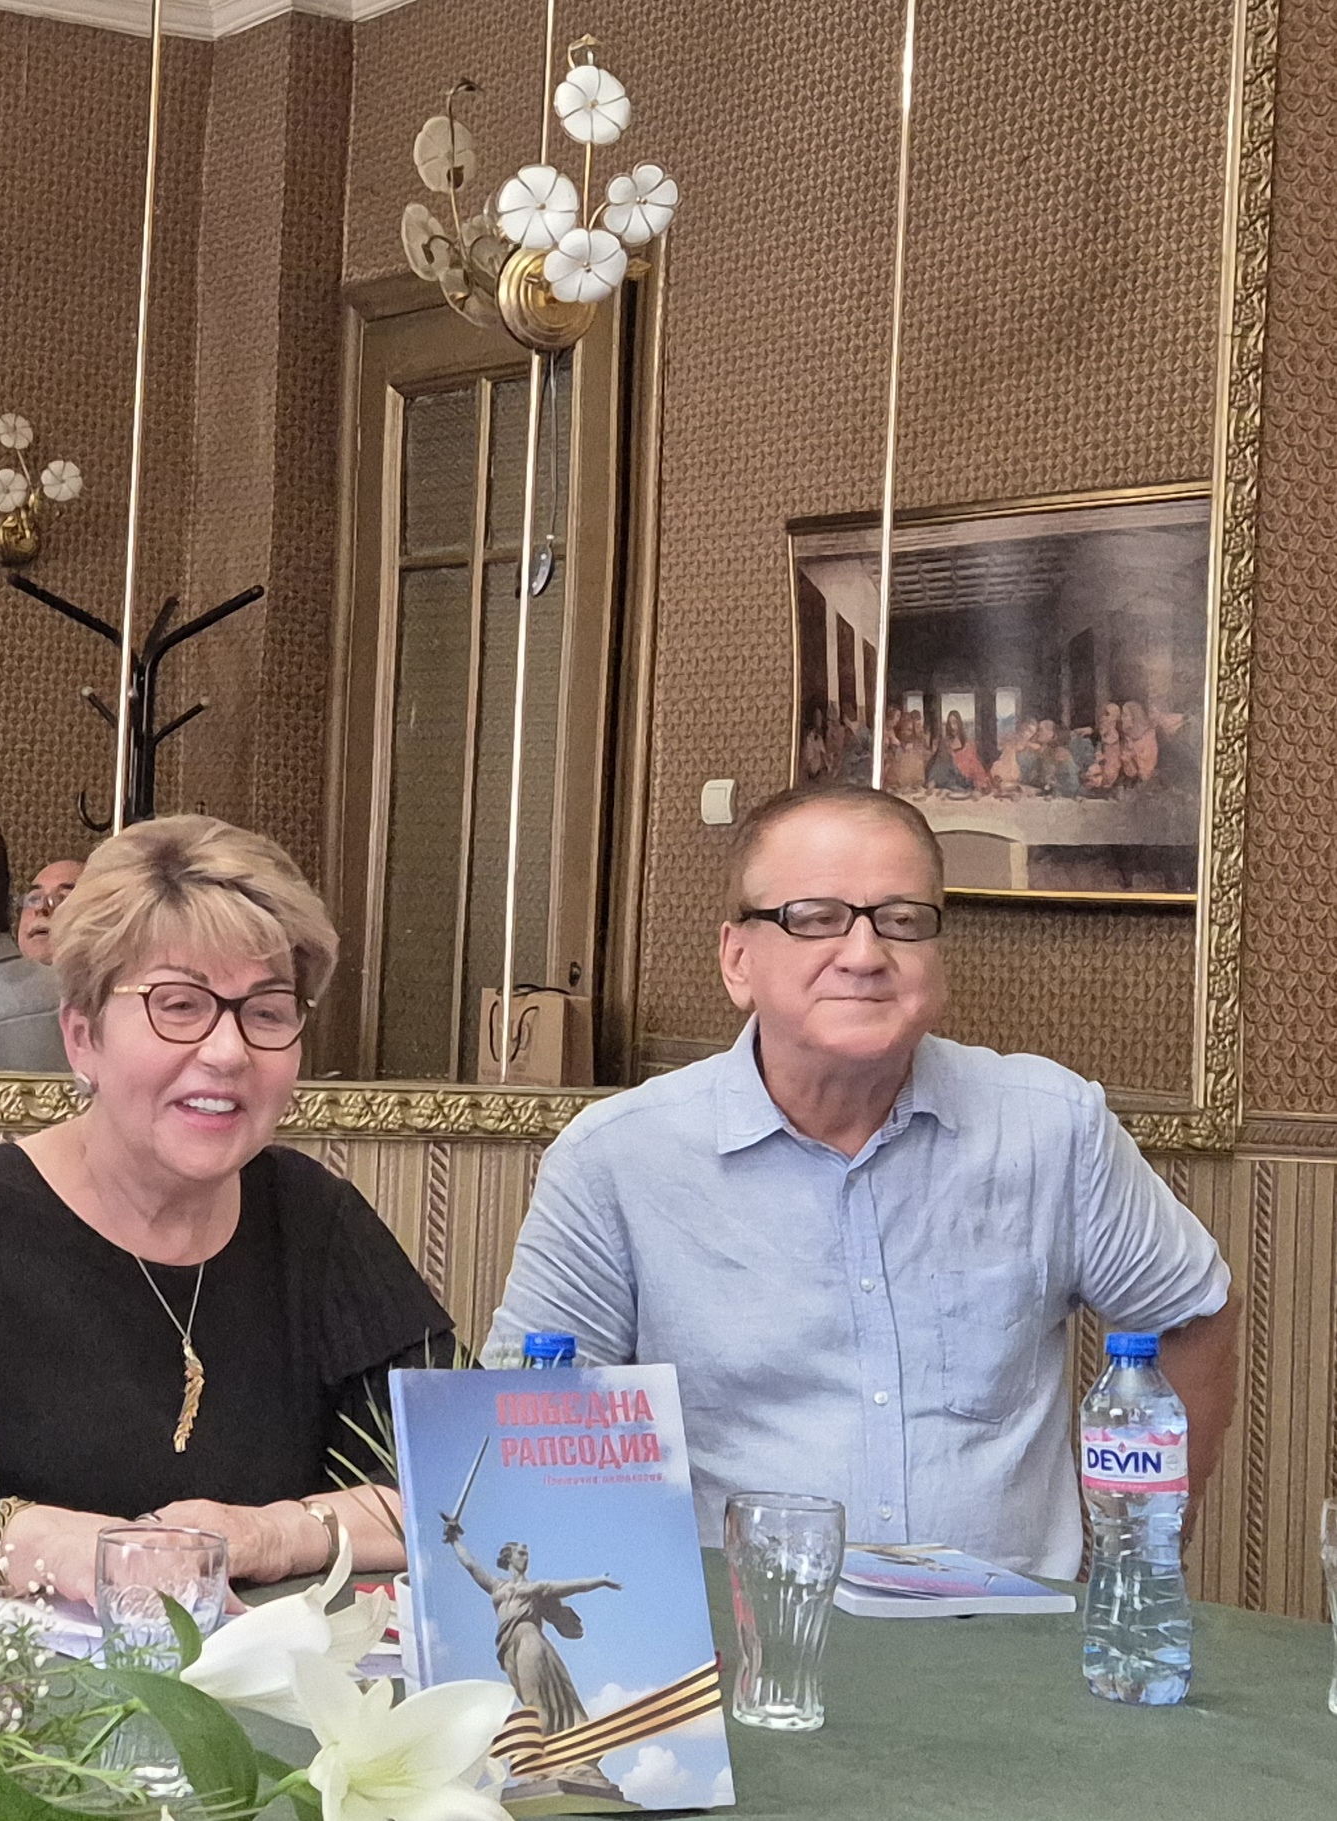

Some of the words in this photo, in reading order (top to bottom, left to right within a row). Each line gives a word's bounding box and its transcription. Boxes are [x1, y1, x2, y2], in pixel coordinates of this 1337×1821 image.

[496, 1389, 654, 1429] ПОБЕДНА
[500, 1432, 662, 1469] РАПСОДИЯ
[1087, 1447, 1162, 1474] DEVIN
